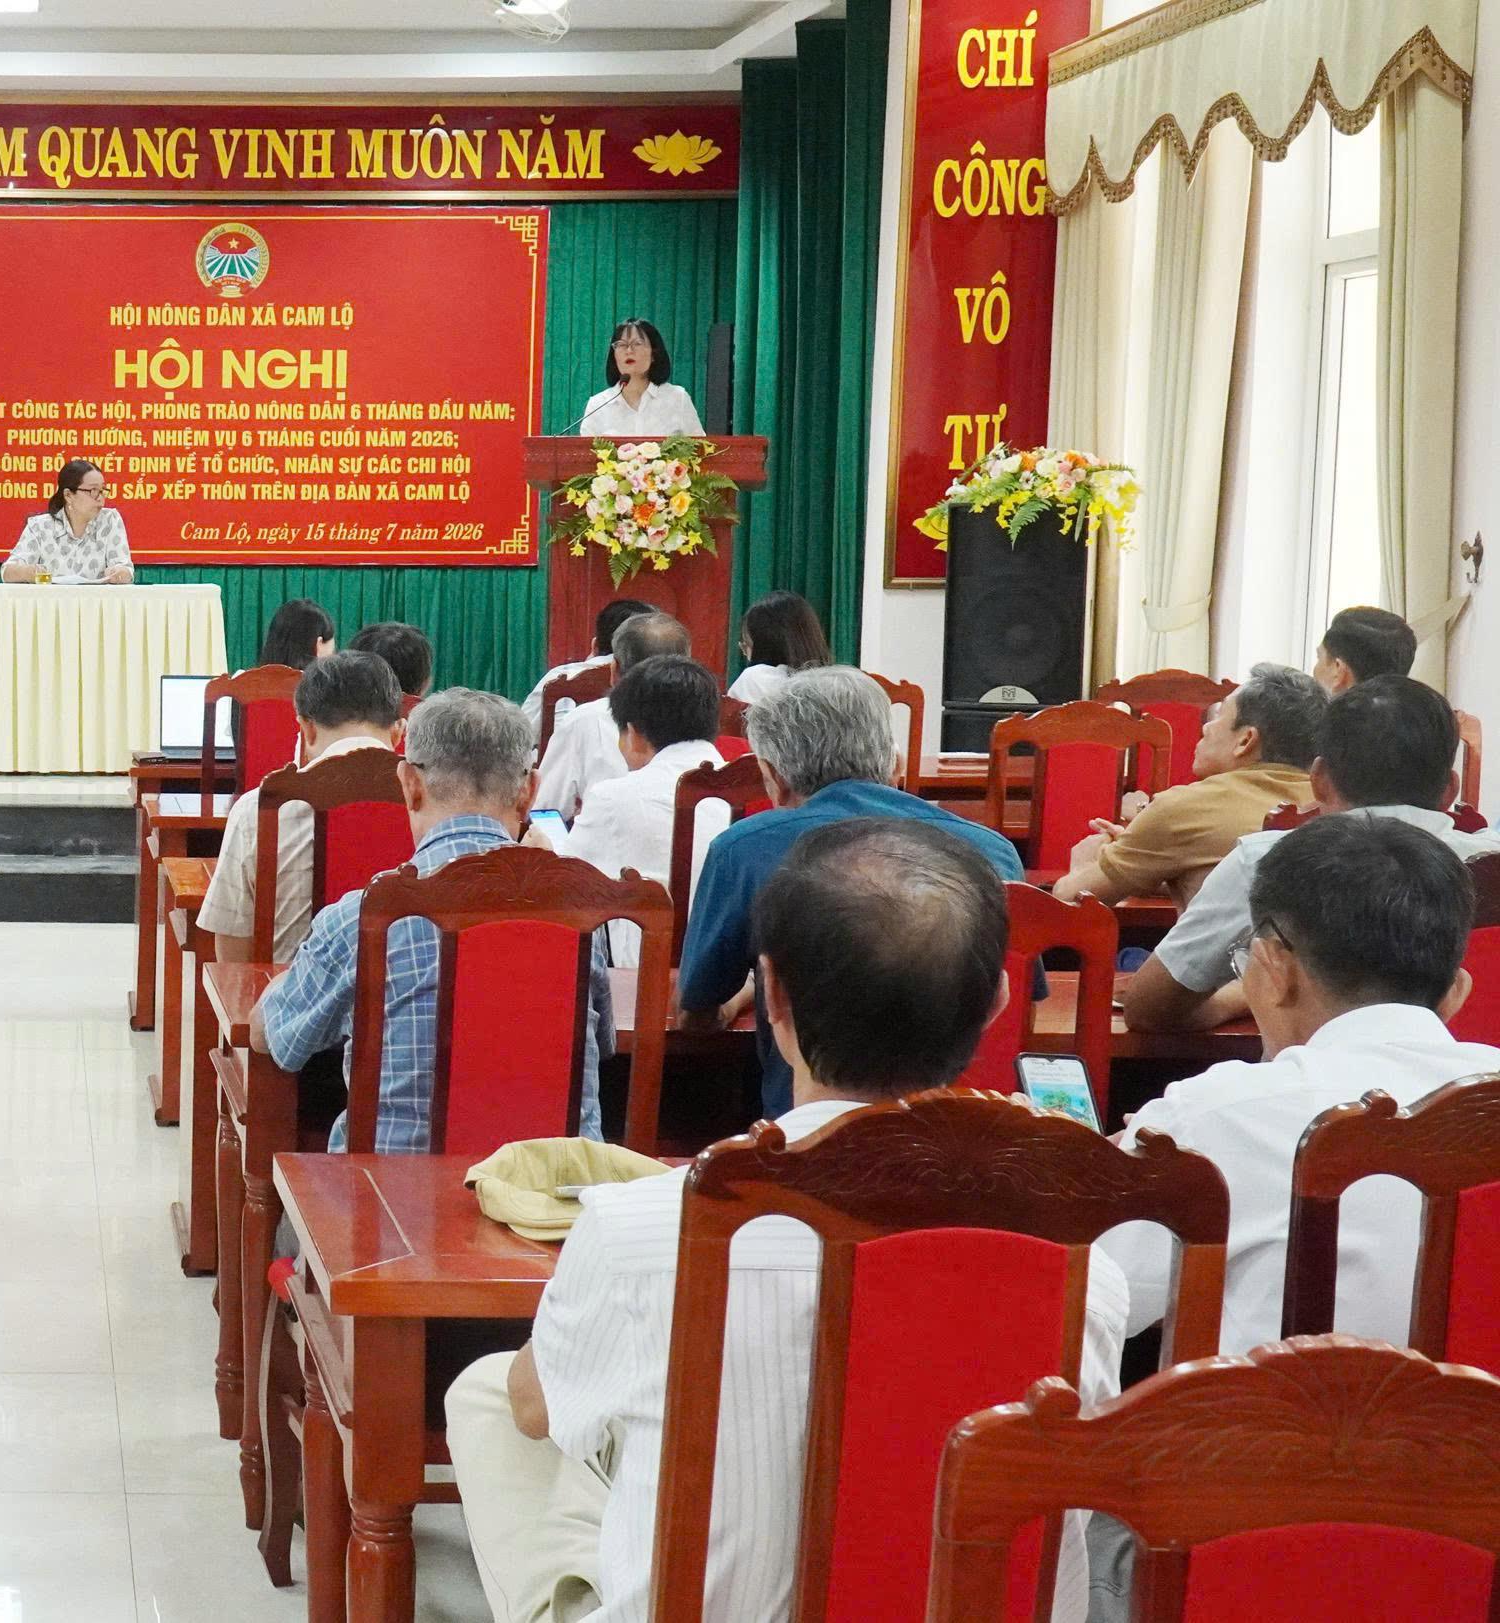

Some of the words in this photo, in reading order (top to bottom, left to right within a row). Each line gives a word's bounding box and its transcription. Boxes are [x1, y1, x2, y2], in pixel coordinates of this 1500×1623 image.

[957, 10, 1038, 88] CHÍ
[38, 125, 199, 189] QUANG
[210, 127, 334, 179] VINH
[347, 115, 487, 180] MUÔN
[498, 116, 606, 180] NĂM
[933, 140, 1047, 218] CÔNG
[110, 303, 141, 330] HỘI
[148, 303, 200, 326] NÔNG
[206, 303, 245, 326] DÂN
[251, 303, 276, 326] XÃ
[282, 306, 325, 326] CAM
[331, 302, 354, 331] LỘ
[954, 270, 1011, 345] VÔ
[114, 338, 203, 401] HỘI
[222, 349, 348, 401] NGHỊ
[12, 399, 60, 420] CÔNG
[64, 400, 97, 420] TÁC
[102, 400, 137, 423] HỘI,
[206, 399, 250, 420] TRÀO
[255, 400, 304, 421] NÔNG
[309, 400, 346, 421] DÂN
[351, 403, 362, 421] 6
[366, 401, 424, 421] THÁNG
[428, 397, 464, 420] ĐẦU
[469, 401, 516, 422] NĂM;
[7, 427, 78, 446] PHƯƠNG
[83, 426, 148, 448] HƯỚNG,
[153, 427, 209, 450] NHIỆM
[214, 430, 237, 450] VỤ
[242, 430, 253, 447] 6
[257, 427, 315, 447] THÁNG
[320, 425, 361, 448] CUỐI
[366, 428, 407, 448] NĂM
[411, 430, 459, 449] 2026;
[42, 450, 67, 473] BỐ
[128, 456, 171, 477] ĐỊNH
[175, 450, 197, 473] VỀ
[202, 450, 224, 474] TỔ
[228, 453, 280, 476] CHỨC,
[285, 454, 334, 474] NHÂN
[338, 455, 364, 477] SỰ
[368, 454, 402, 474] CÁC
[407, 457, 437, 474] CHI
[441, 454, 471, 477] HỘI
[122, 473, 158, 500] SẮP
[162, 478, 197, 500] XẾP
[201, 480, 247, 500] THÔN
[251, 480, 296, 500] TRÊN
[300, 483, 330, 504] ĐỊA
[335, 481, 371, 501] BÀN
[375, 481, 400, 501] XÃ
[404, 484, 444, 501] CAM
[449, 481, 471, 504] LỘ
[180, 522, 220, 541] Cam
[224, 522, 252, 545] Lộ,
[256, 523, 301, 545] ngày
[304, 523, 325, 541] 15
[328, 522, 383, 545] tháng
[386, 524, 398, 541] 7
[399, 523, 439, 541] năm
[442, 523, 485, 541] 2026
